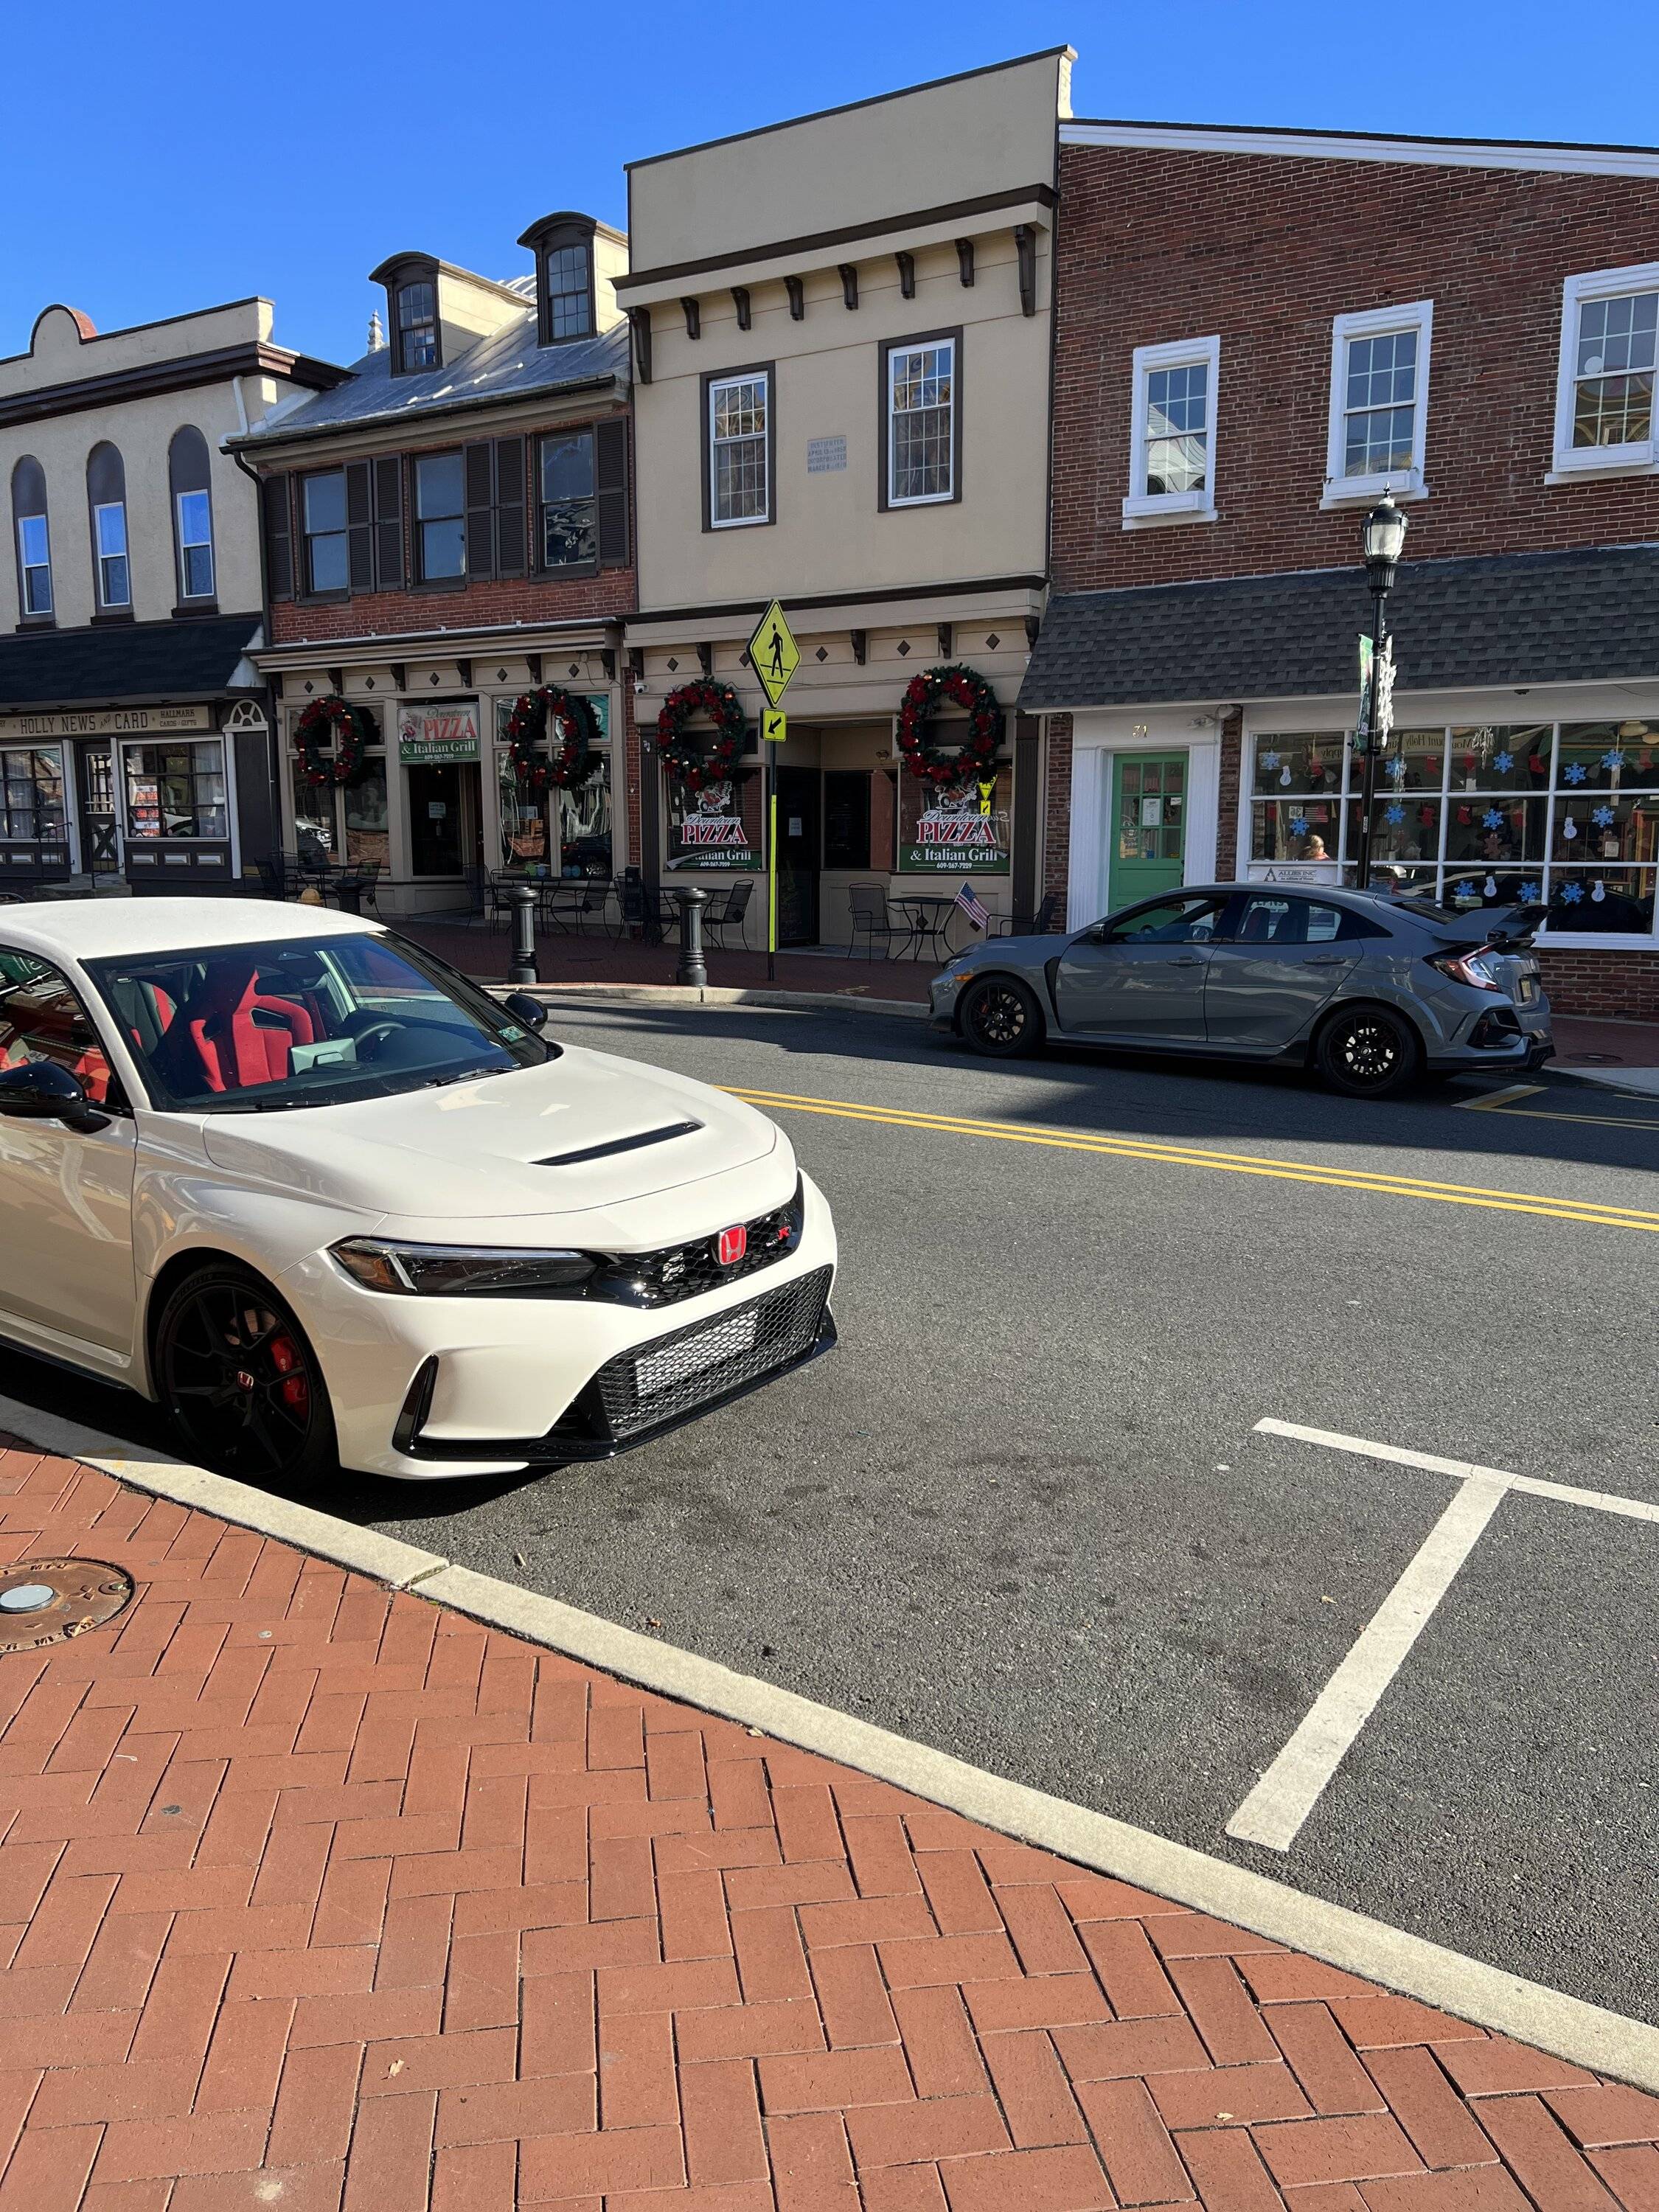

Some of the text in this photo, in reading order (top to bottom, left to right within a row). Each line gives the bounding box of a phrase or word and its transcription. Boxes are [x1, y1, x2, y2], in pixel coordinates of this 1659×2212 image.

[160, 709, 195, 718] HALLMARK
[20, 717, 55, 734] HOLLY
[61, 714, 96, 732] NEWS
[100, 713, 111, 728] AND
[115, 712, 147, 729] CARD
[424, 717, 476, 740] PIZZA
[1133, 725, 1147, 738] 31
[402, 740, 476, 754] & Italian Grill
[686, 813, 741, 824] Downtown
[922, 810, 989, 821] Downtown
[681, 823, 748, 845] PIZZA
[916, 820, 997, 844] PIZZA
[726, 849, 751, 860] Grill
[910, 848, 998, 861] & Italian Grill
